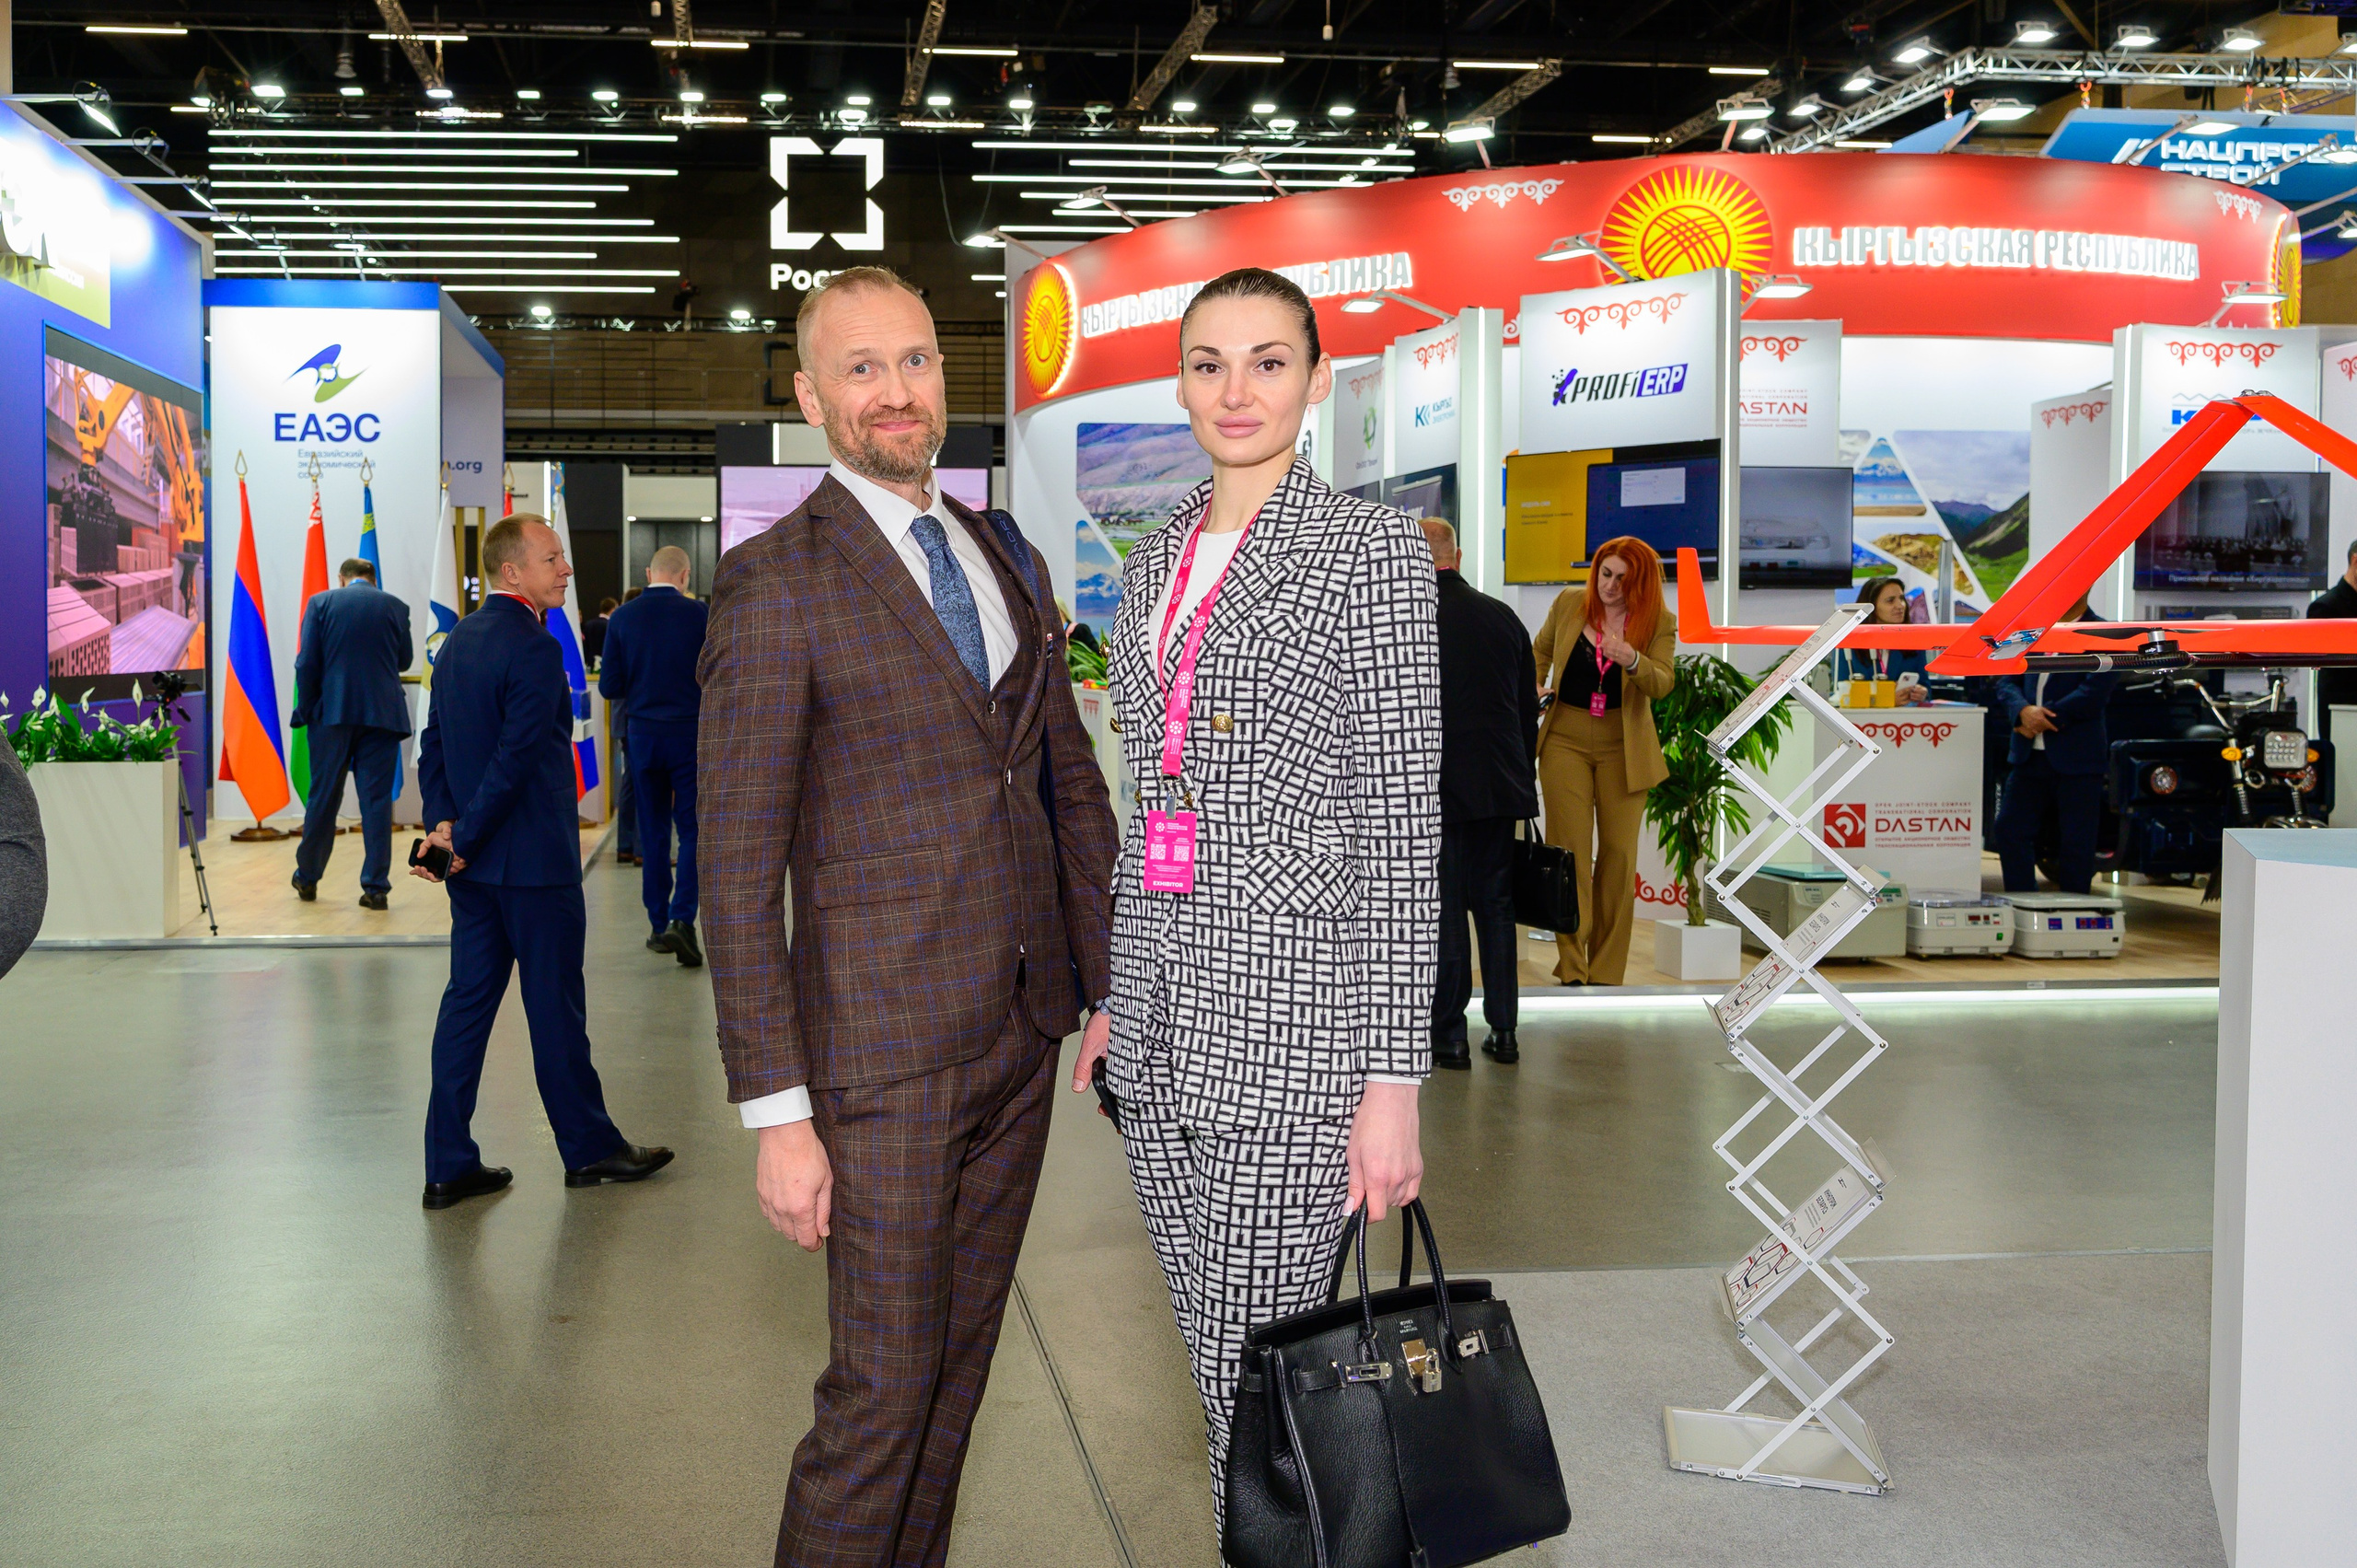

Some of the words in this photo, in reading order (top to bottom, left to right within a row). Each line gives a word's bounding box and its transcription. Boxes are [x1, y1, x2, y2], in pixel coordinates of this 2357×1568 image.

[2161, 139, 2357, 165] НАЦПРОЕ
[1794, 226, 2034, 268] КЫРГЫЗСКАЯ
[2036, 229, 2200, 281] РЕСПУБЛИКА
[771, 263, 844, 291] Рос
[1081, 280, 1217, 339] КЫРГЫЗСКА
[1271, 251, 1412, 299] УБЛИКА
[1739, 401, 1807, 414] ASTAN
[274, 412, 380, 442] ЕАЭС
[1875, 817, 1971, 832] DASTAN
